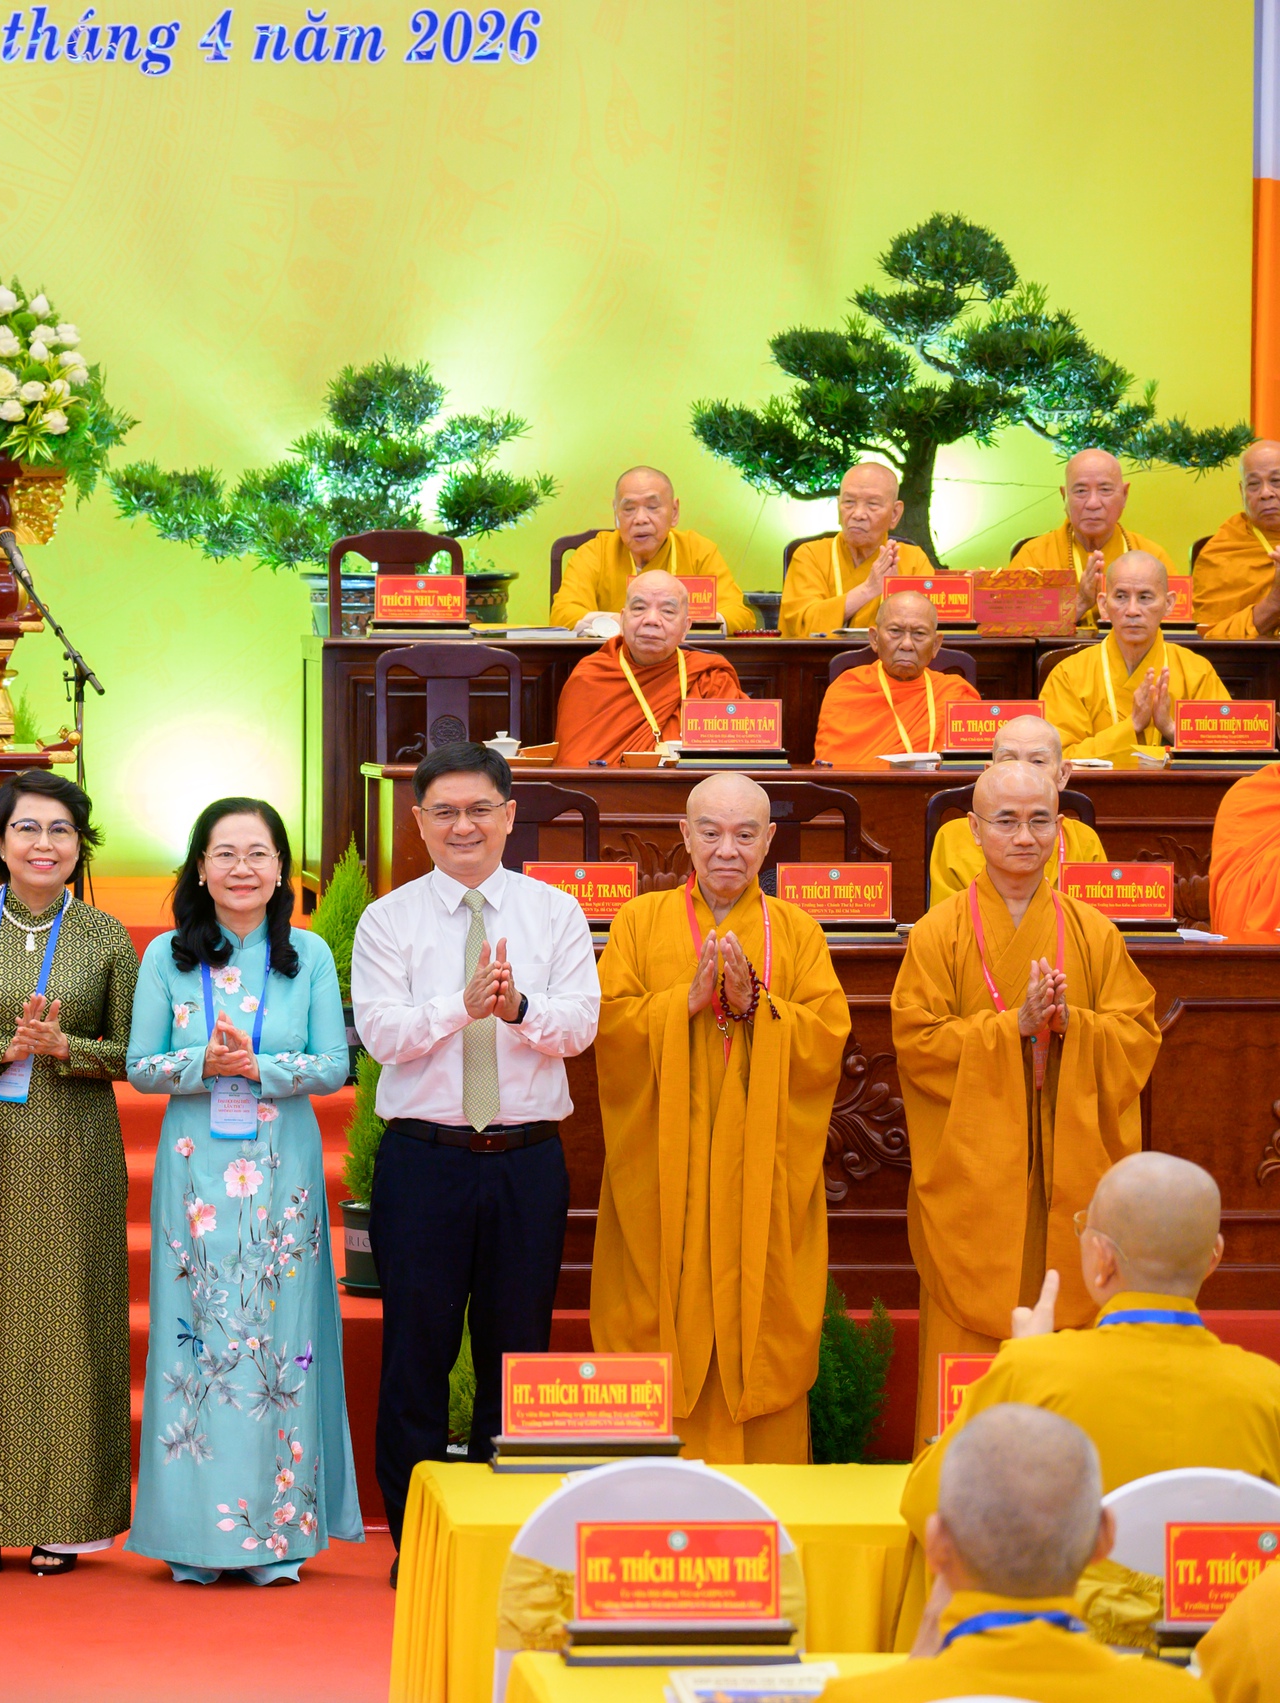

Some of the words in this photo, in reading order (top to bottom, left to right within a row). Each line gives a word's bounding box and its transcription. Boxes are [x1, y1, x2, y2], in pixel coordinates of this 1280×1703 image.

[1, 4, 181, 75] tháng
[196, 8, 233, 61] 4
[252, 9, 385, 62] năm
[405, 9, 541, 62] 2026
[381, 592, 411, 606] THÍCH
[414, 595, 435, 606] NHƯ
[438, 593, 461, 610] NIỆM
[692, 589, 712, 604] PHÁP
[930, 591, 945, 607] HUỆ
[948, 594, 969, 605] MINH
[688, 718, 700, 730] HT.
[703, 715, 728, 730] THÍCH
[730, 717, 755, 734] THIỆN
[757, 716, 774, 730] TÂM
[952, 720, 964, 732] HT.
[967, 720, 995, 735] THẠCH
[1181, 719, 1193, 730] HT.
[1195, 715, 1218, 730] THÍCH
[1220, 717, 1241, 734] THIỆN
[551, 880, 578, 898] HÍCH
[581, 881, 594, 901] LỆ
[597, 885, 631, 898] TRANG
[785, 886, 798, 899] TT.
[802, 881, 830, 899] THÍCH
[833, 882, 861, 902] THIỆN
[864, 881, 884, 901] QUÝ
[1068, 885, 1082, 898] HT.
[1085, 881, 1113, 898] THÍCH
[1116, 882, 1143, 902] THIỆN
[1146, 882, 1165, 899] ĐỨC
[513, 1385, 535, 1404] HT.
[538, 1378, 578, 1404] THÍCH
[582, 1385, 627, 1404] THANH
[631, 1380, 662, 1410] HIỆN
[587, 1557, 616, 1582] HT.
[620, 1549, 674, 1582] THÍCH
[679, 1557, 730, 1589] HẠNH
[1176, 1559, 1202, 1585] TT.
[1206, 1552, 1261, 1585] THÍCH
